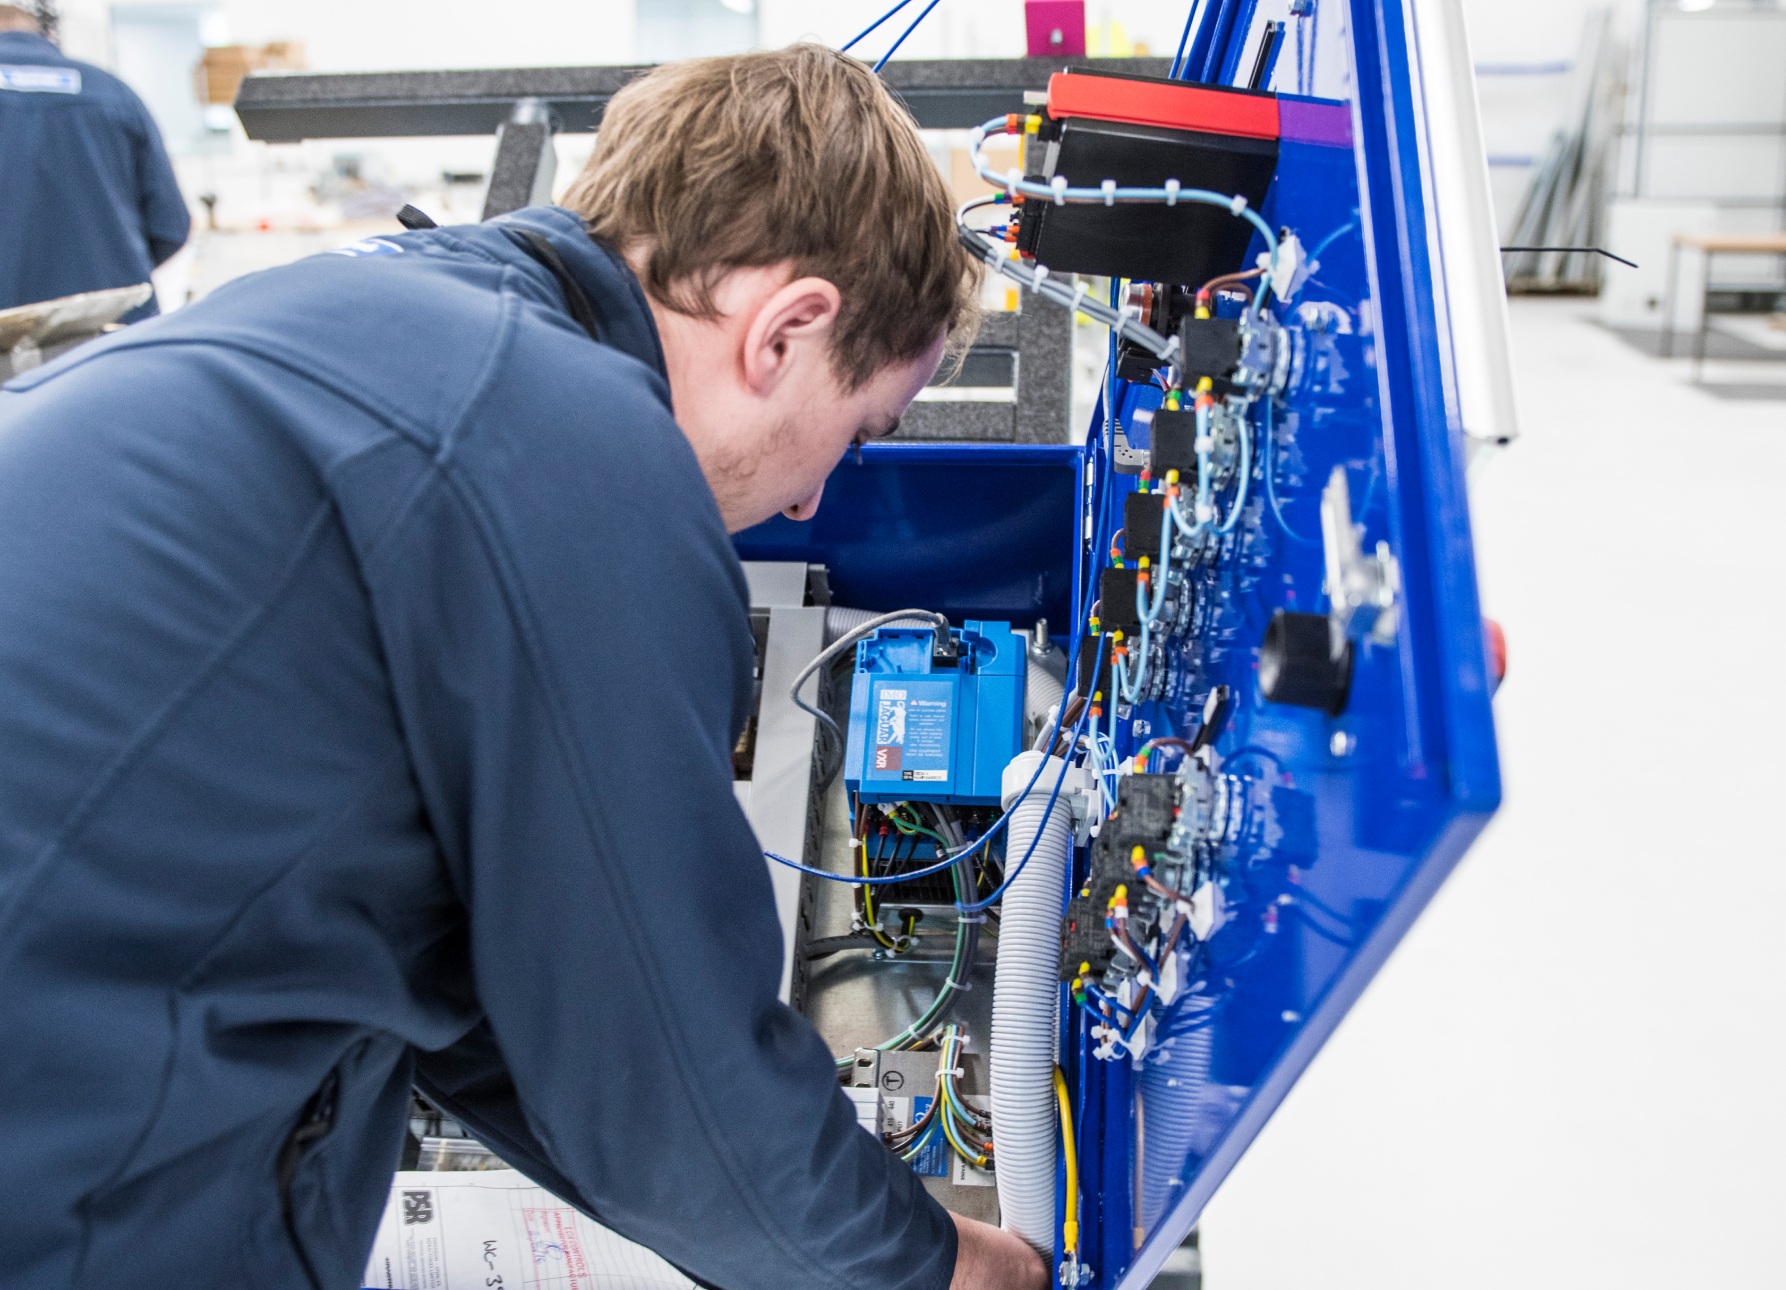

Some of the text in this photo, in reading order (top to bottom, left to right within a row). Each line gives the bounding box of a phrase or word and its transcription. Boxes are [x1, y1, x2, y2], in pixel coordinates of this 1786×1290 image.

[883, 691, 905, 699] IMO
[878, 702, 891, 744] JAGUAR
[876, 748, 888, 769] VXR
[402, 1190, 433, 1226] PSR
